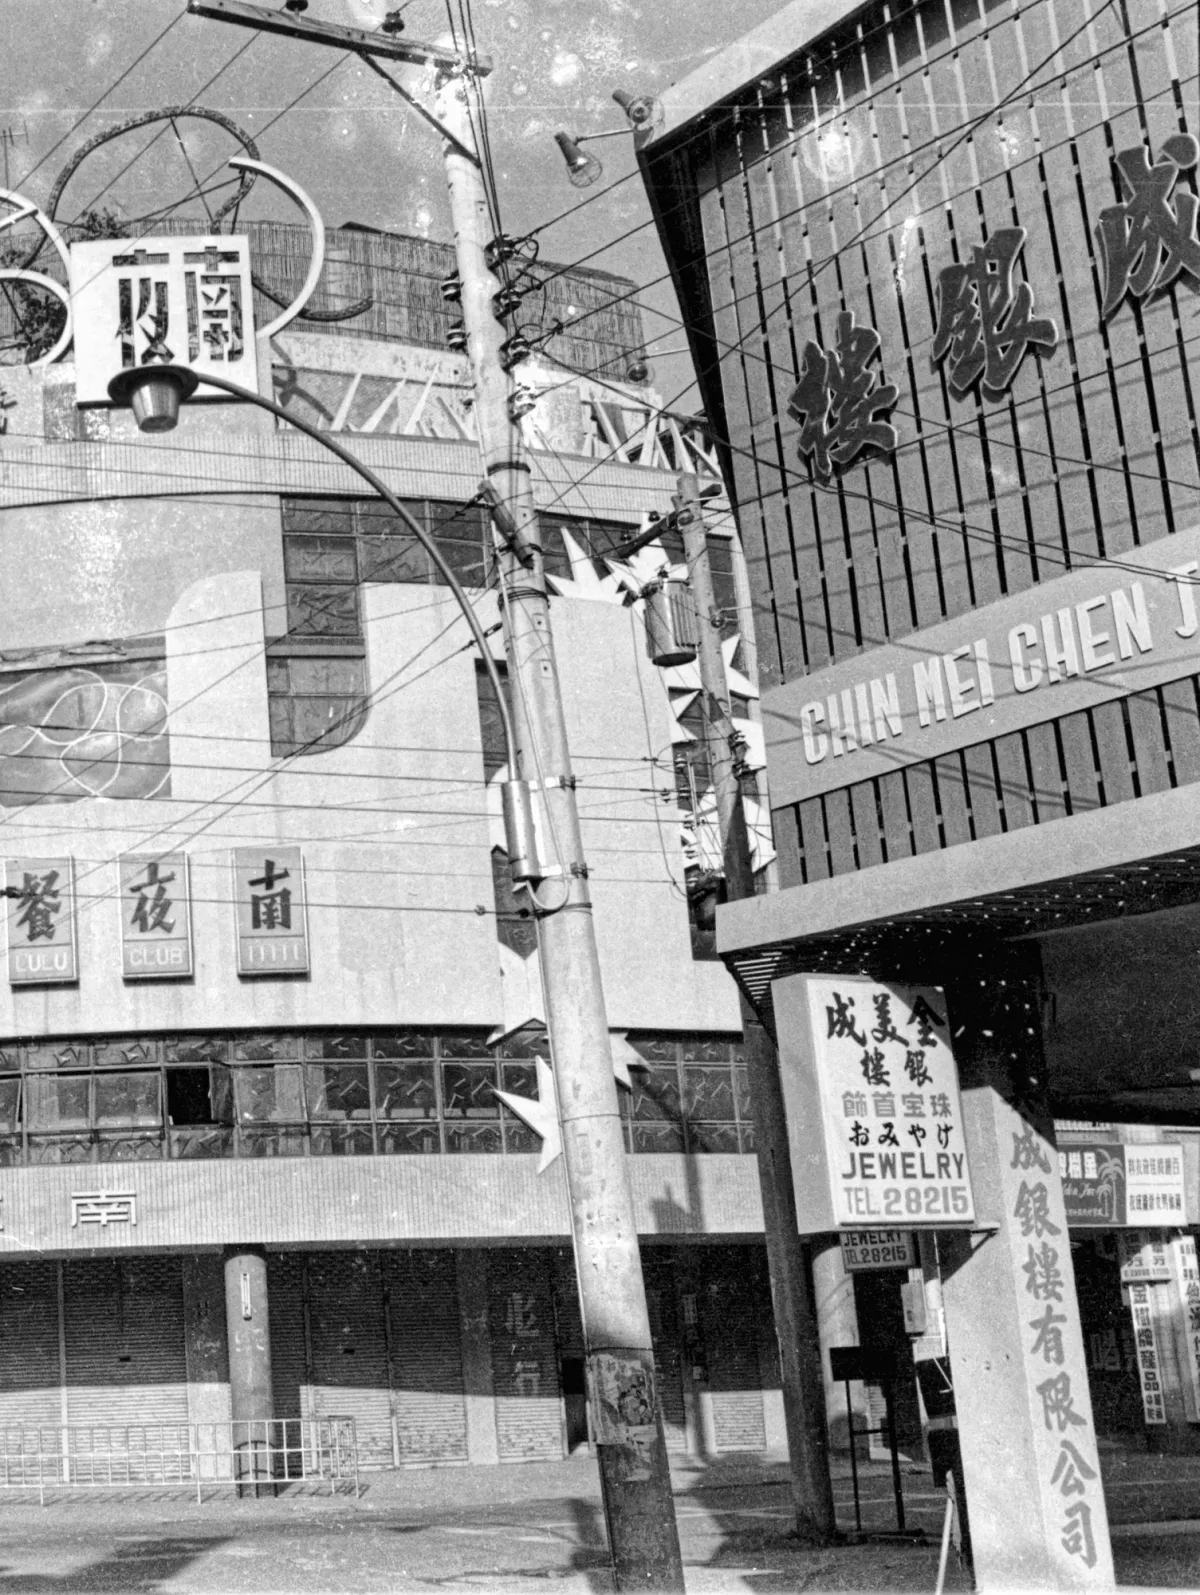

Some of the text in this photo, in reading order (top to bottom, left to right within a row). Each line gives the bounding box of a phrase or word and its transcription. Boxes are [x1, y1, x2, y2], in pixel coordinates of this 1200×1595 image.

[800, 672, 902, 765] CHIN
[912, 638, 995, 728] MEI
[1007, 581, 1153, 693] CHEN
[15, 952, 68, 973] LULU
[129, 948, 184, 968] CLUB
[842, 1152, 963, 1179] JEWELRY
[883, 1186, 969, 1215] 28215
[860, 1245, 907, 1264] 28215
